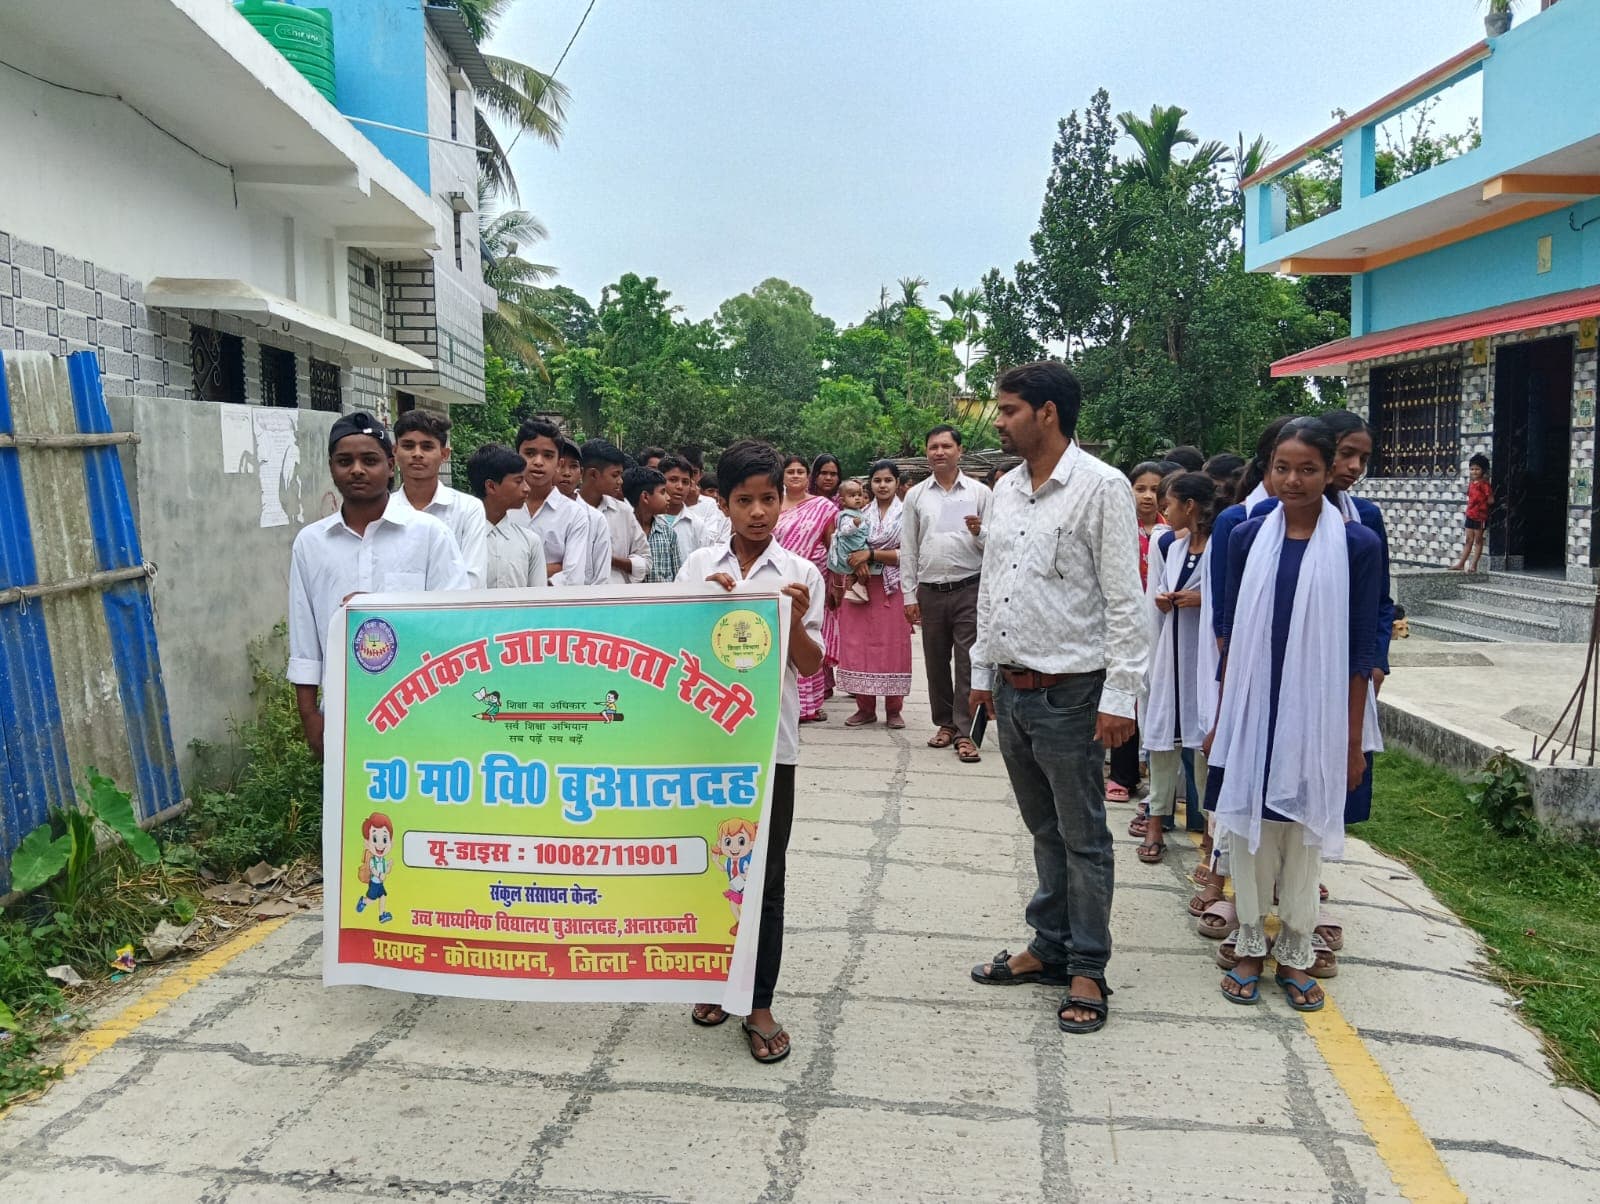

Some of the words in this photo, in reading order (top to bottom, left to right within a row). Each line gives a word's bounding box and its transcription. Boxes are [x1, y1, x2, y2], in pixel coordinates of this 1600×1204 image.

[366, 638, 491, 733] नामांकन
[679, 649, 756, 734] रैली
[506, 699, 527, 710] शिक्षा
[533, 701, 544, 710] का
[504, 721, 519, 731] सर्व
[525, 721, 546, 731] शिक्षा
[551, 721, 588, 732] अभियान
[509, 734, 524, 743] सब
[548, 734, 563, 743] सब
[557, 764, 759, 823] बुआलदह
[534, 843, 678, 866] 10082711901
[489, 880, 522, 908] संकुल
[411, 909, 434, 927] उच्च
[496, 910, 551, 934] विद्यालय
[372, 937, 427, 965] प्रखण्ड
[642, 945, 734, 974] किशनगं
